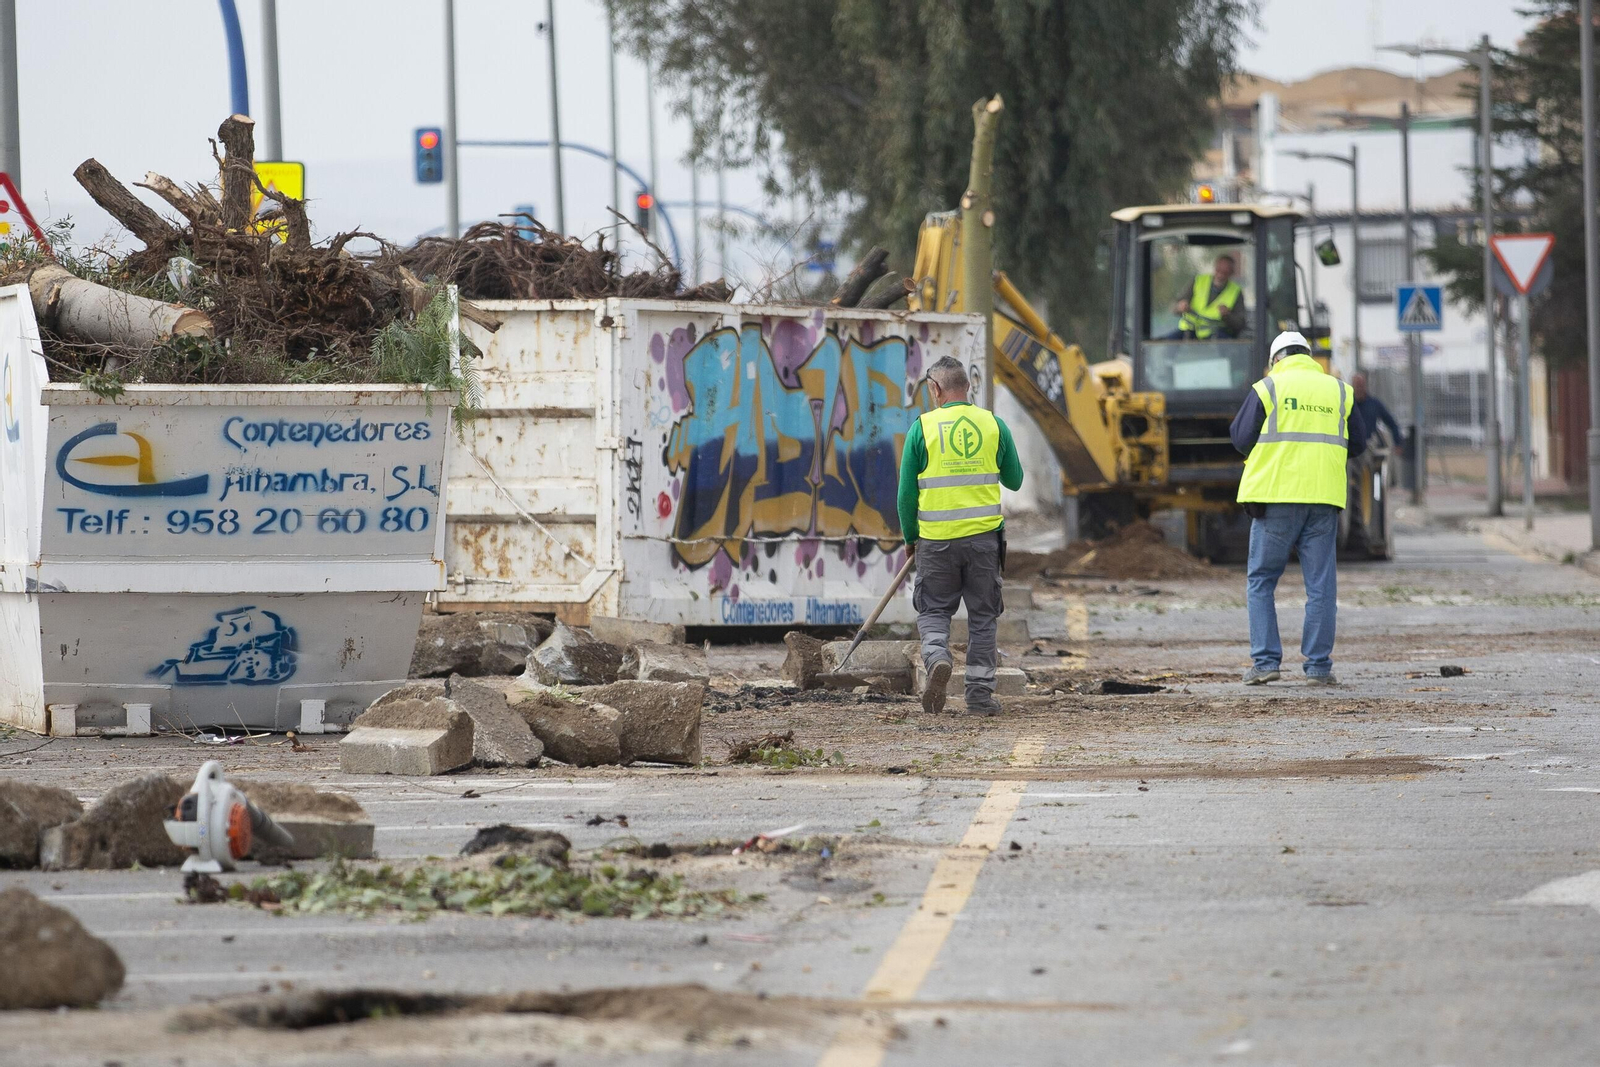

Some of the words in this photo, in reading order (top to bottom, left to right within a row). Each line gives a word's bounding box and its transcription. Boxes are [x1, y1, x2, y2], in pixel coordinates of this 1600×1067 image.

[222, 416, 432, 453] Contenedores
[166, 507, 241, 536] 958
[252, 507, 302, 535] 20
[317, 507, 367, 535] 60
[379, 506, 429, 533] 80
[720, 596, 795, 624] Contenedores
